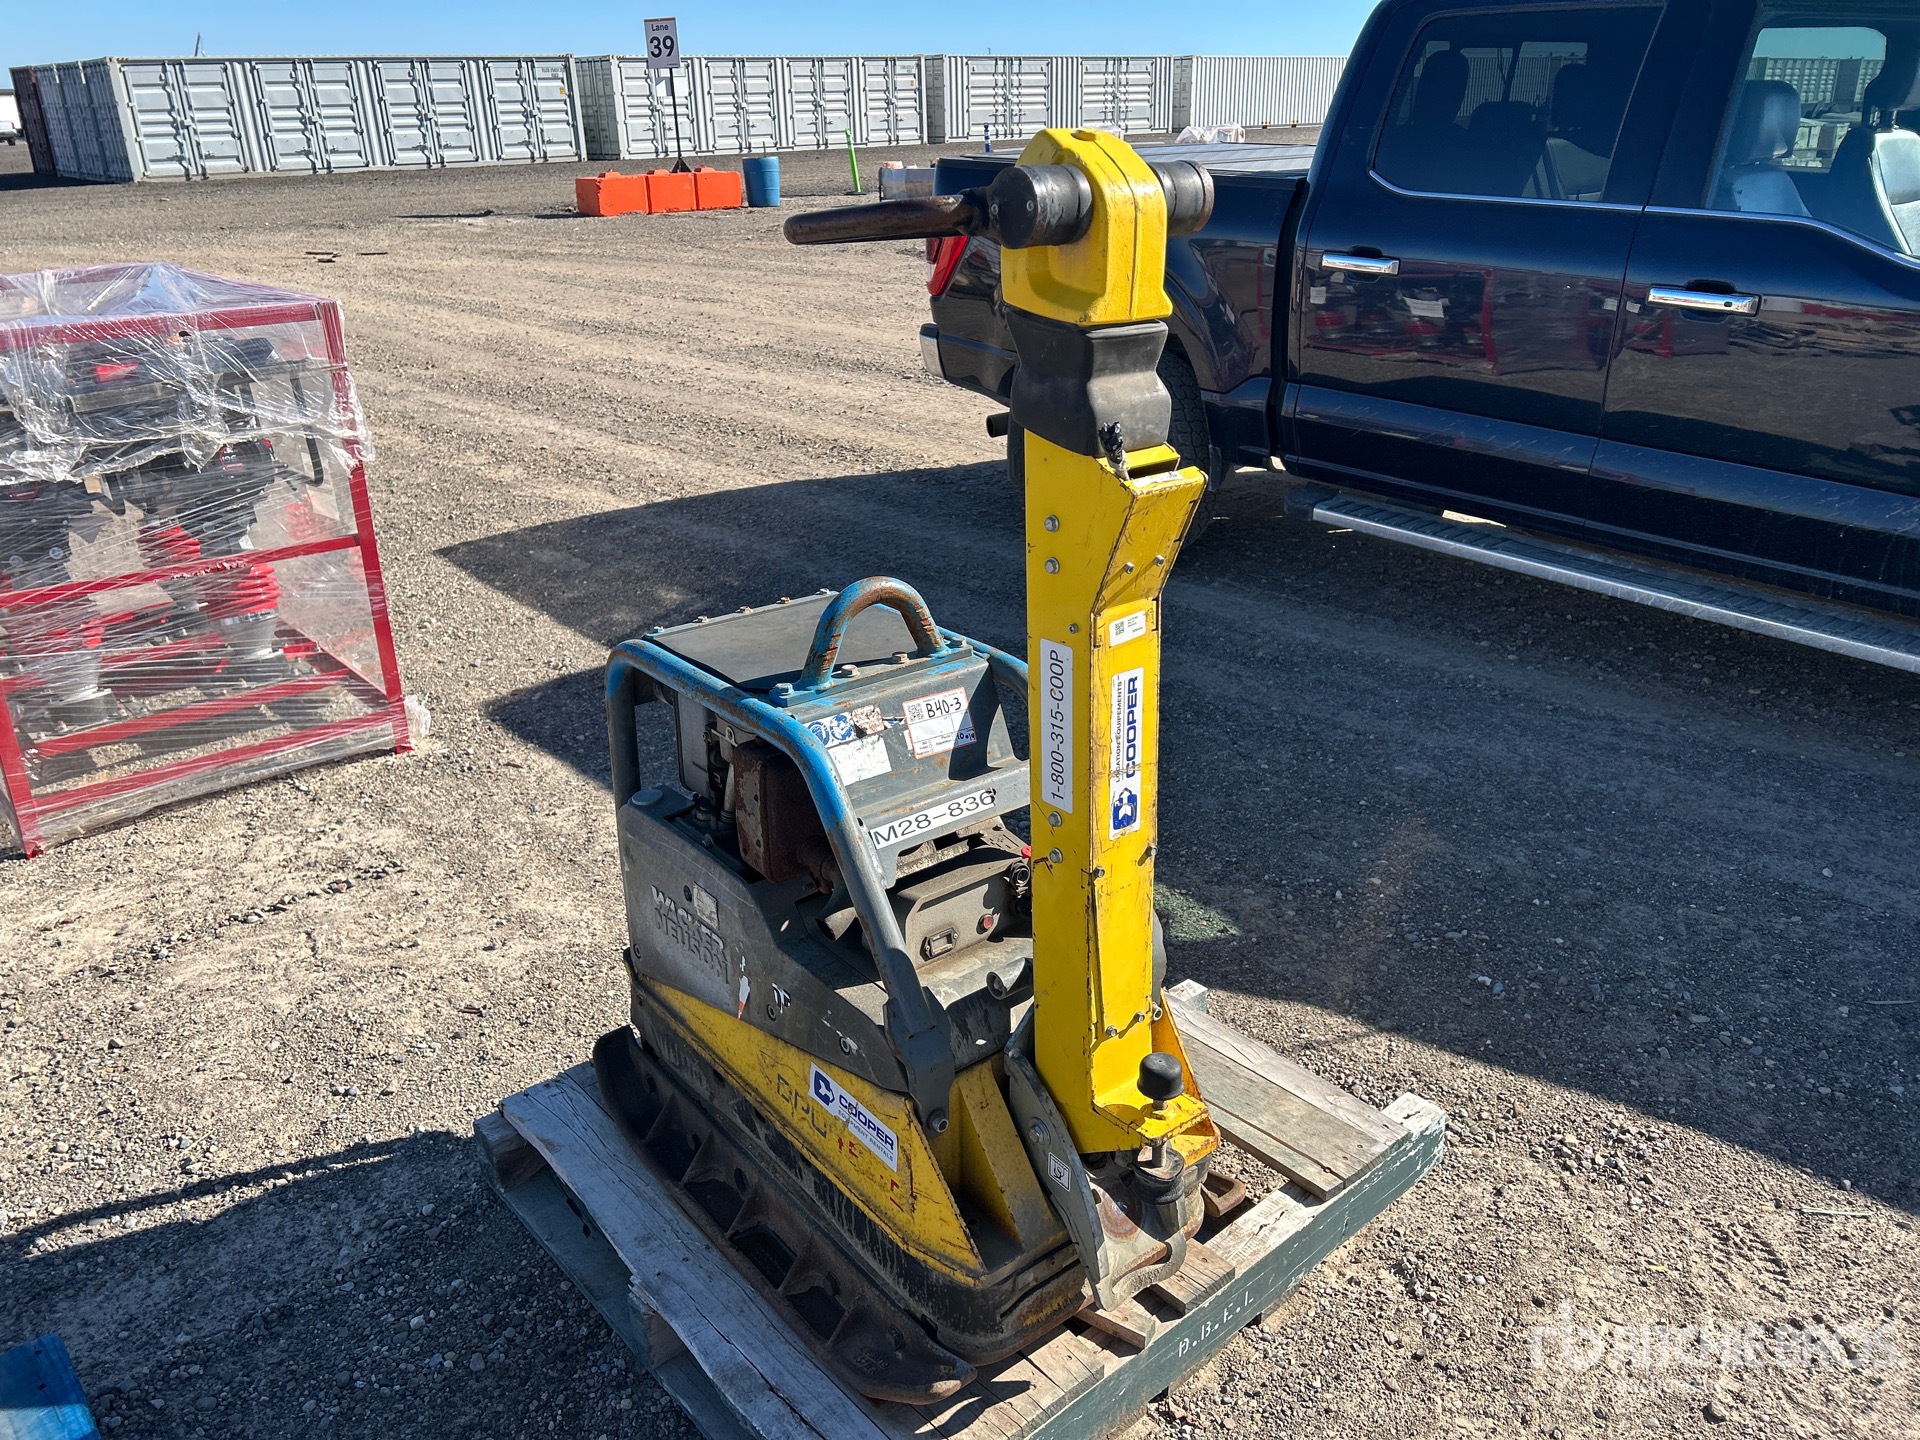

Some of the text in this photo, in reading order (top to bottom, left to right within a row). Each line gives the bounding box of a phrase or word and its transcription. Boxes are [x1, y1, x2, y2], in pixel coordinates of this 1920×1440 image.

[649, 35, 675, 58] 39
[651, 23, 669, 32] Lane
[925, 697, 962, 718] B40-3
[1050, 649, 1065, 800] 1-800-315-COOP
[1126, 676, 1138, 779] COOPER
[873, 790, 996, 845] M28-836
[839, 1094, 894, 1151] COOPER
[869, 1138, 894, 1162] RENTALS
